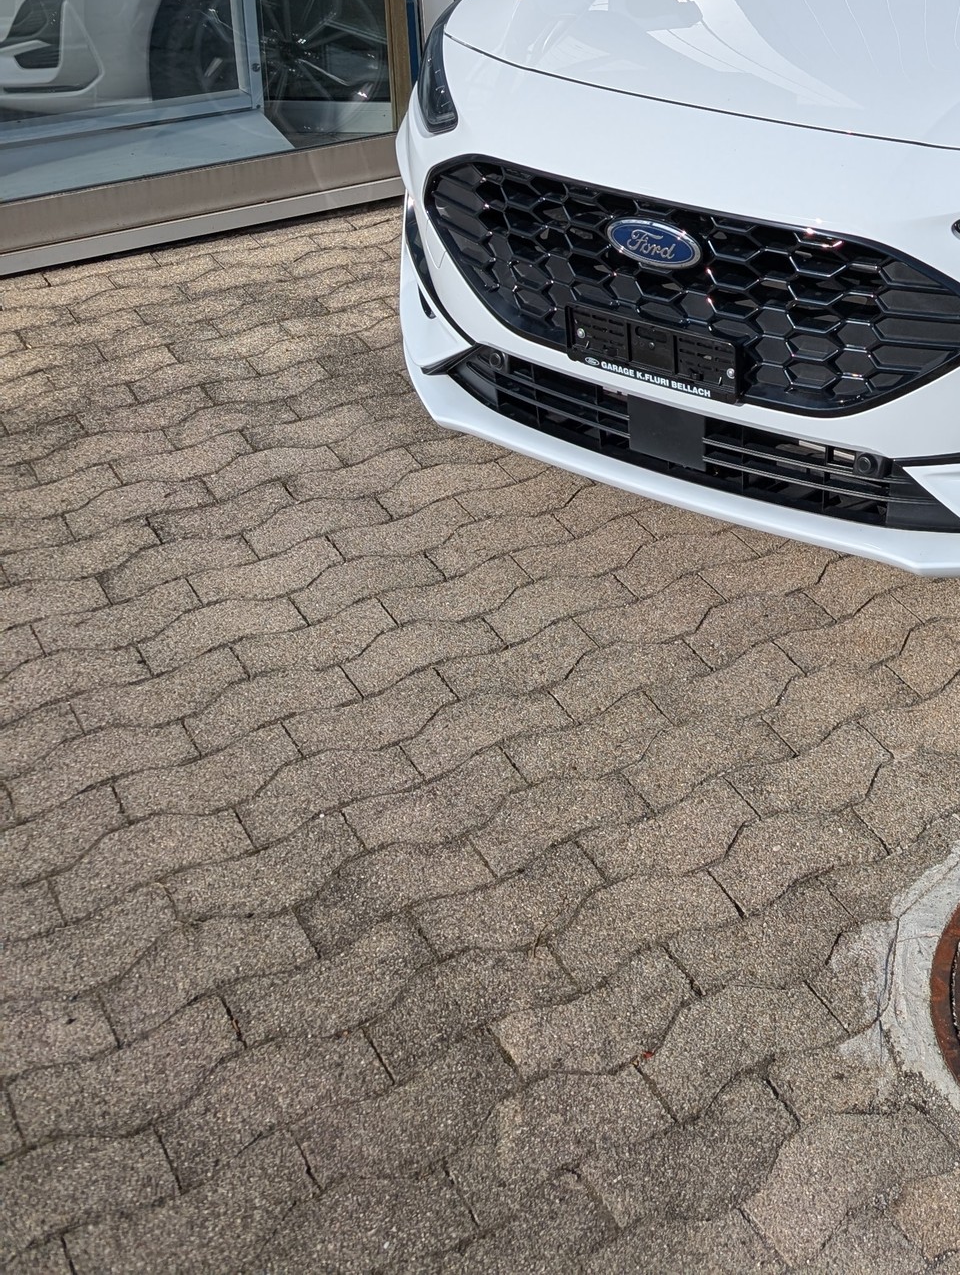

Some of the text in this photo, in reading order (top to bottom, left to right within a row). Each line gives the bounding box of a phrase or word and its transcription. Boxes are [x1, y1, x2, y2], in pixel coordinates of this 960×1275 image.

[626, 228, 676, 260] Ford
[601, 361, 635, 376] GARAGE
[636, 372, 670, 386] K.FLURI
[671, 382, 711, 397] BELLACH
